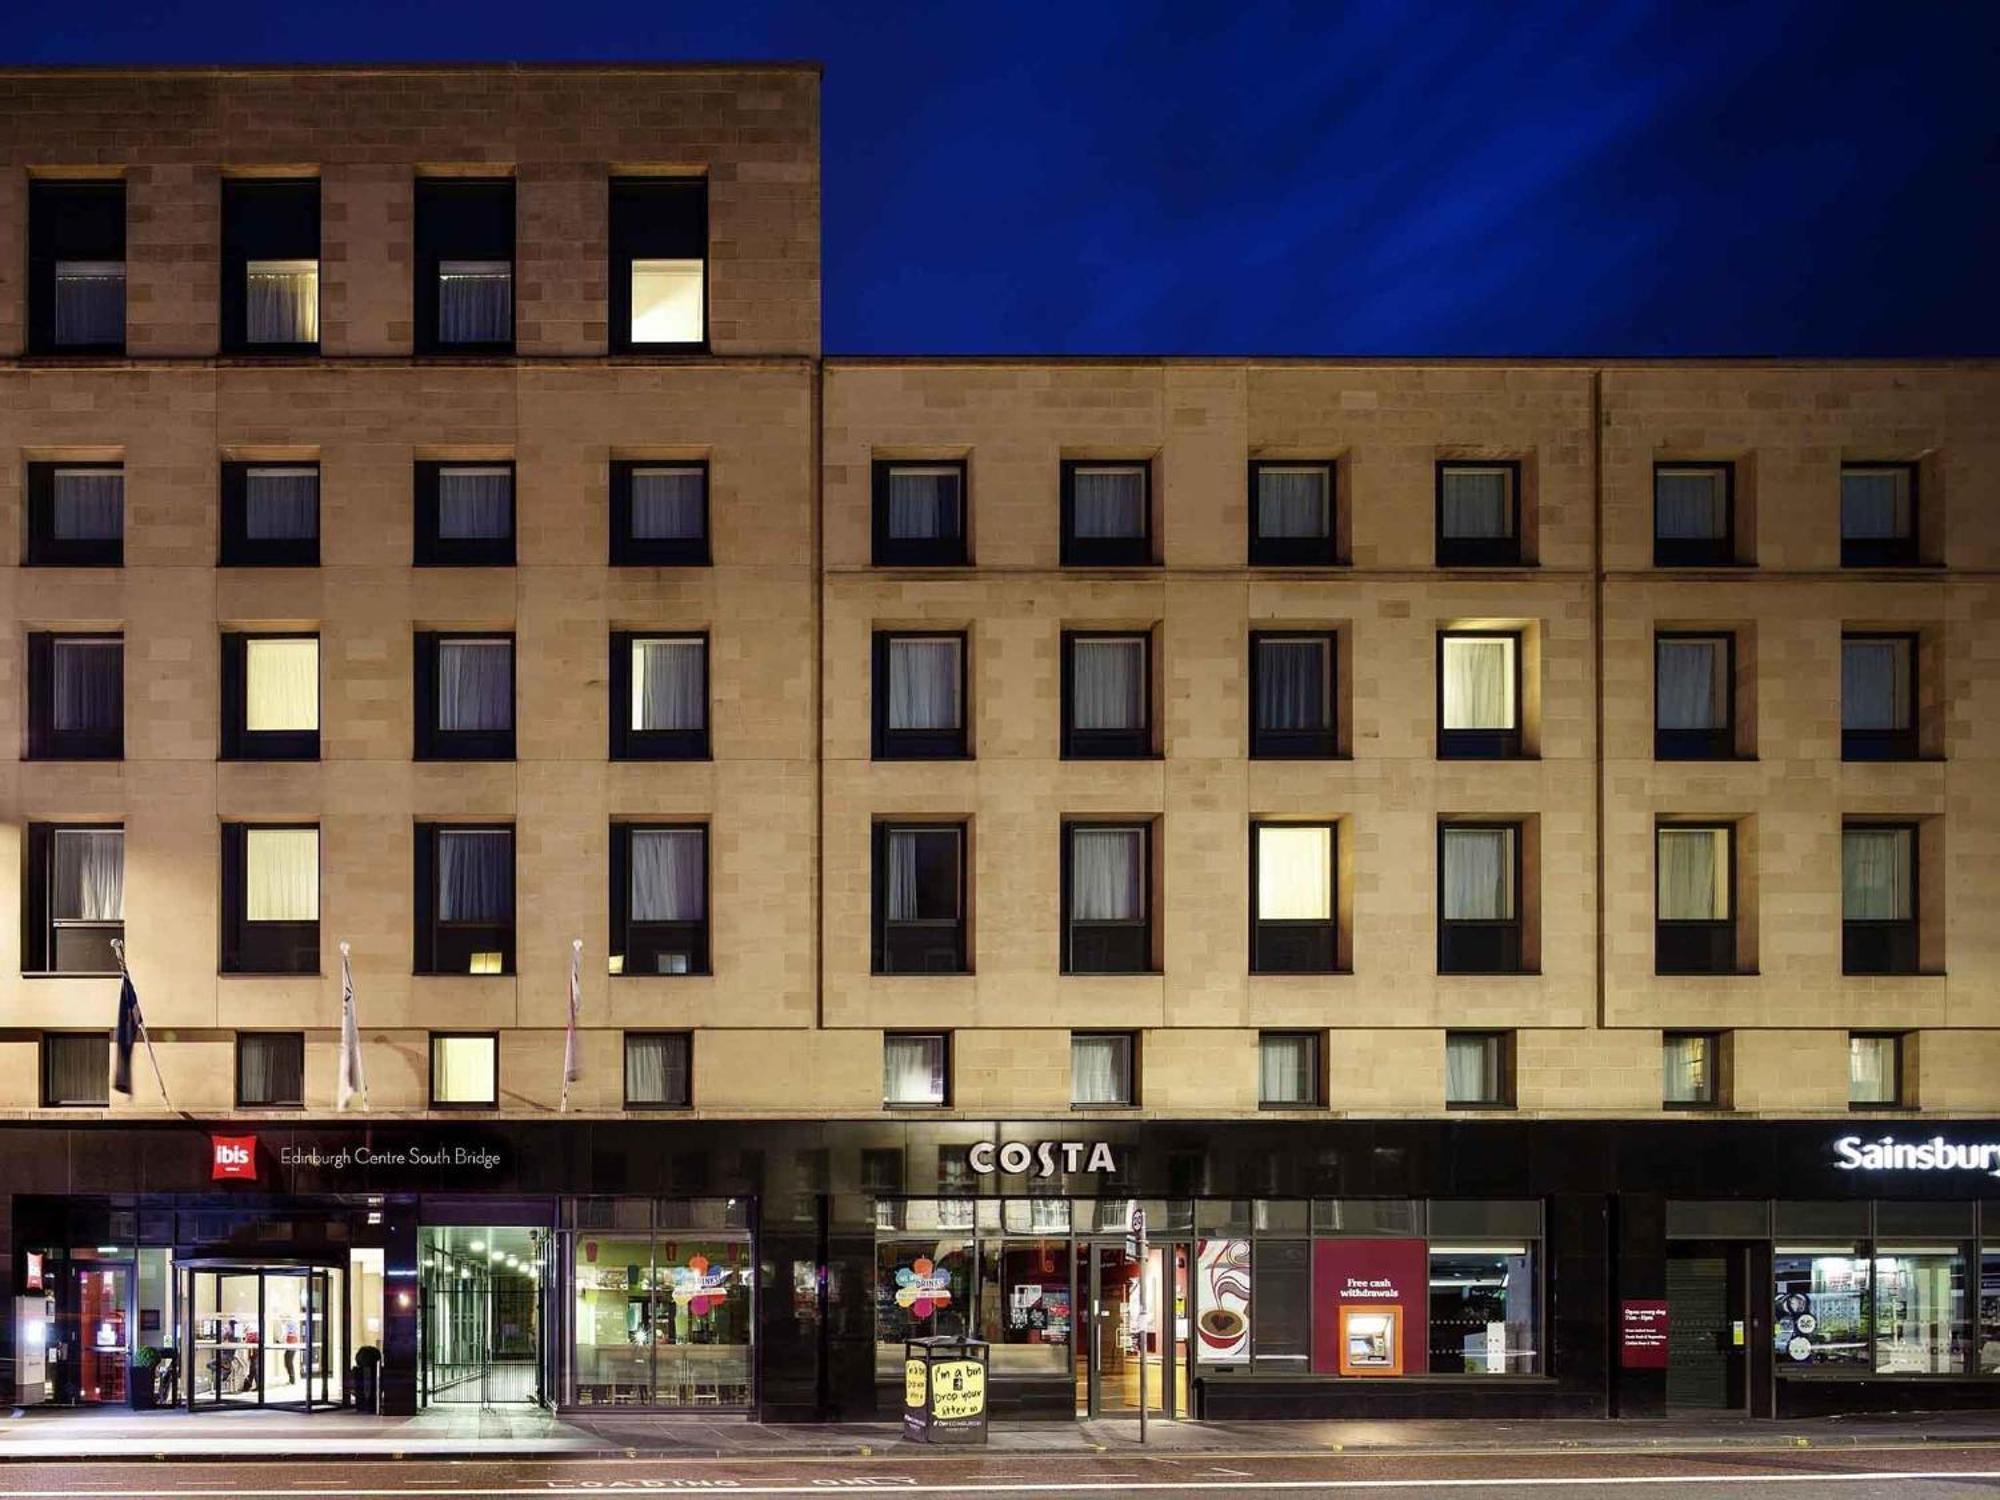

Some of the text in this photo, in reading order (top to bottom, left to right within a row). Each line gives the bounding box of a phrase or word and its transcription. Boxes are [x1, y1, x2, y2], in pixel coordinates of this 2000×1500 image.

[216, 1145, 249, 1164] ibis
[280, 1146, 501, 1169] Edinburgh Centre South Bridge
[969, 1142, 1116, 1177] COSTA
[1347, 1278, 1392, 1288] Free cash
[1340, 1288, 1399, 1298] withdrawals
[934, 1366, 950, 1382] I'm
[954, 1368, 963, 1378] a
[966, 1365, 982, 1378] bin
[934, 1393, 958, 1404] Drop
[961, 1390, 982, 1402] your
[547, 1476, 919, 1488] LOADING ONLY
